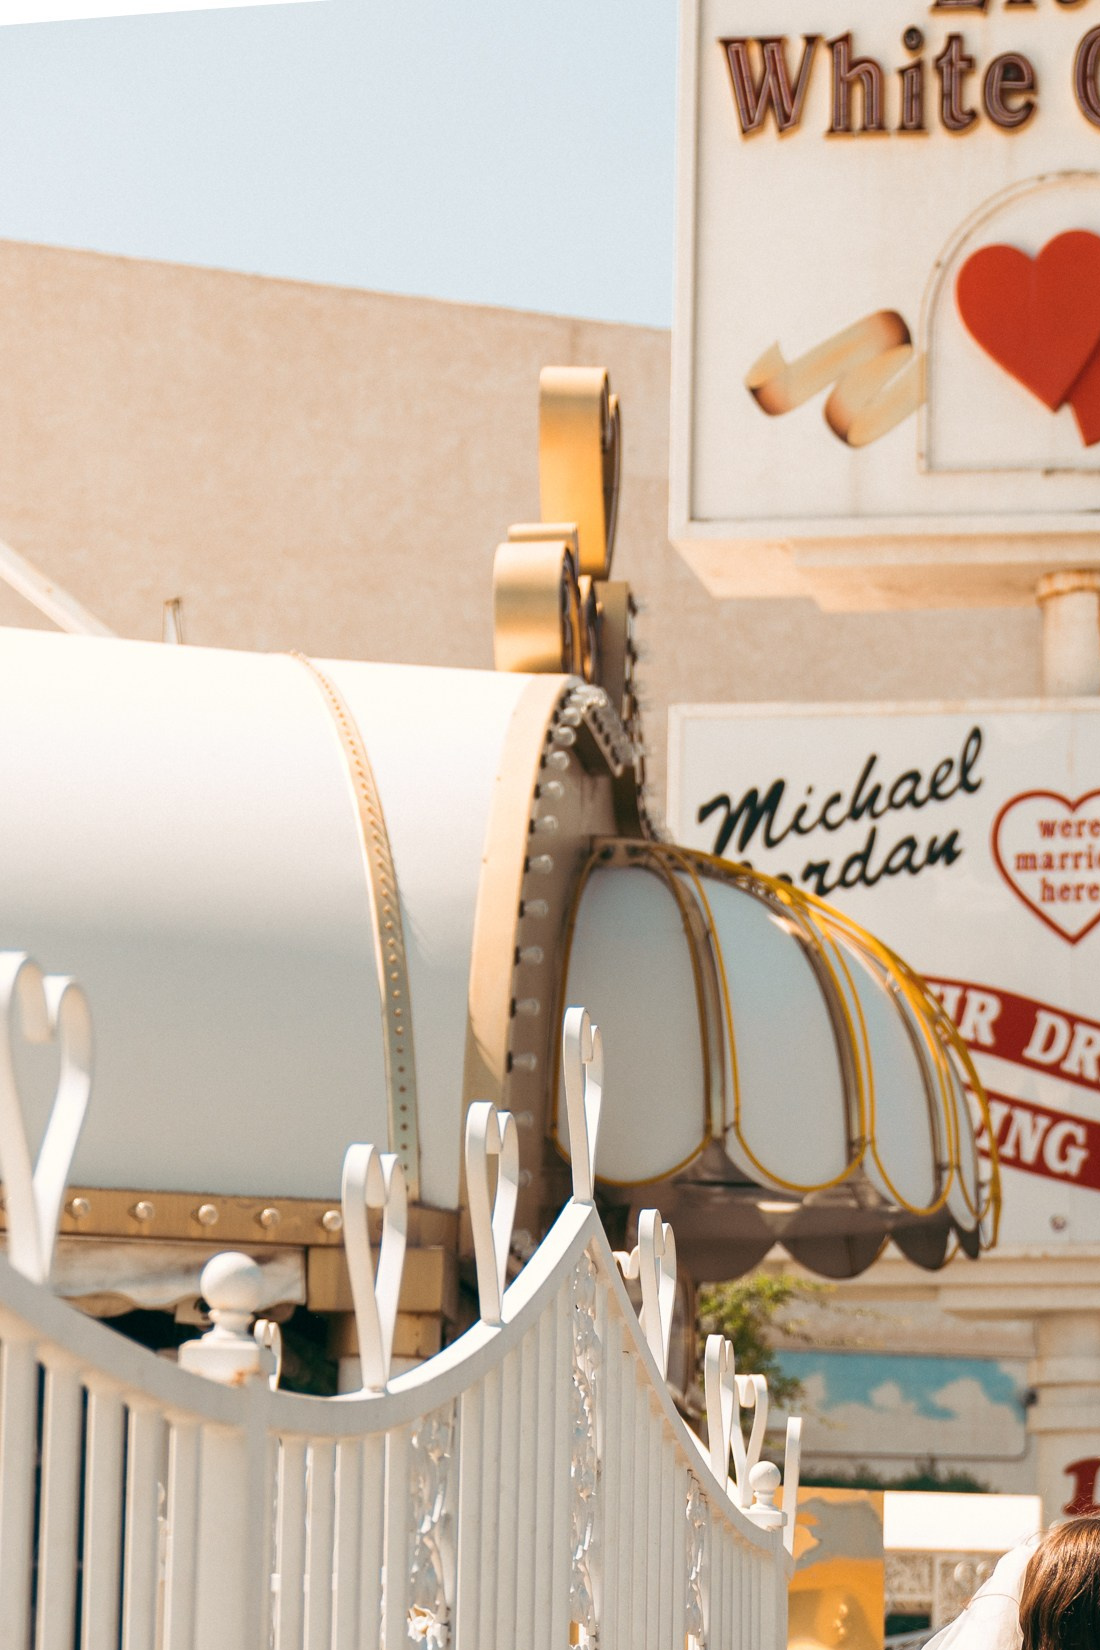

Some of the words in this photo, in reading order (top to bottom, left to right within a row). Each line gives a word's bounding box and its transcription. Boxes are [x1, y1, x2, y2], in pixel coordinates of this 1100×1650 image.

[719, 28, 1037, 139] White
[697, 726, 983, 856] Michael
[742, 826, 962, 896] rdan
[1040, 877, 1100, 902] here
[967, 1092, 1089, 1178] ING
